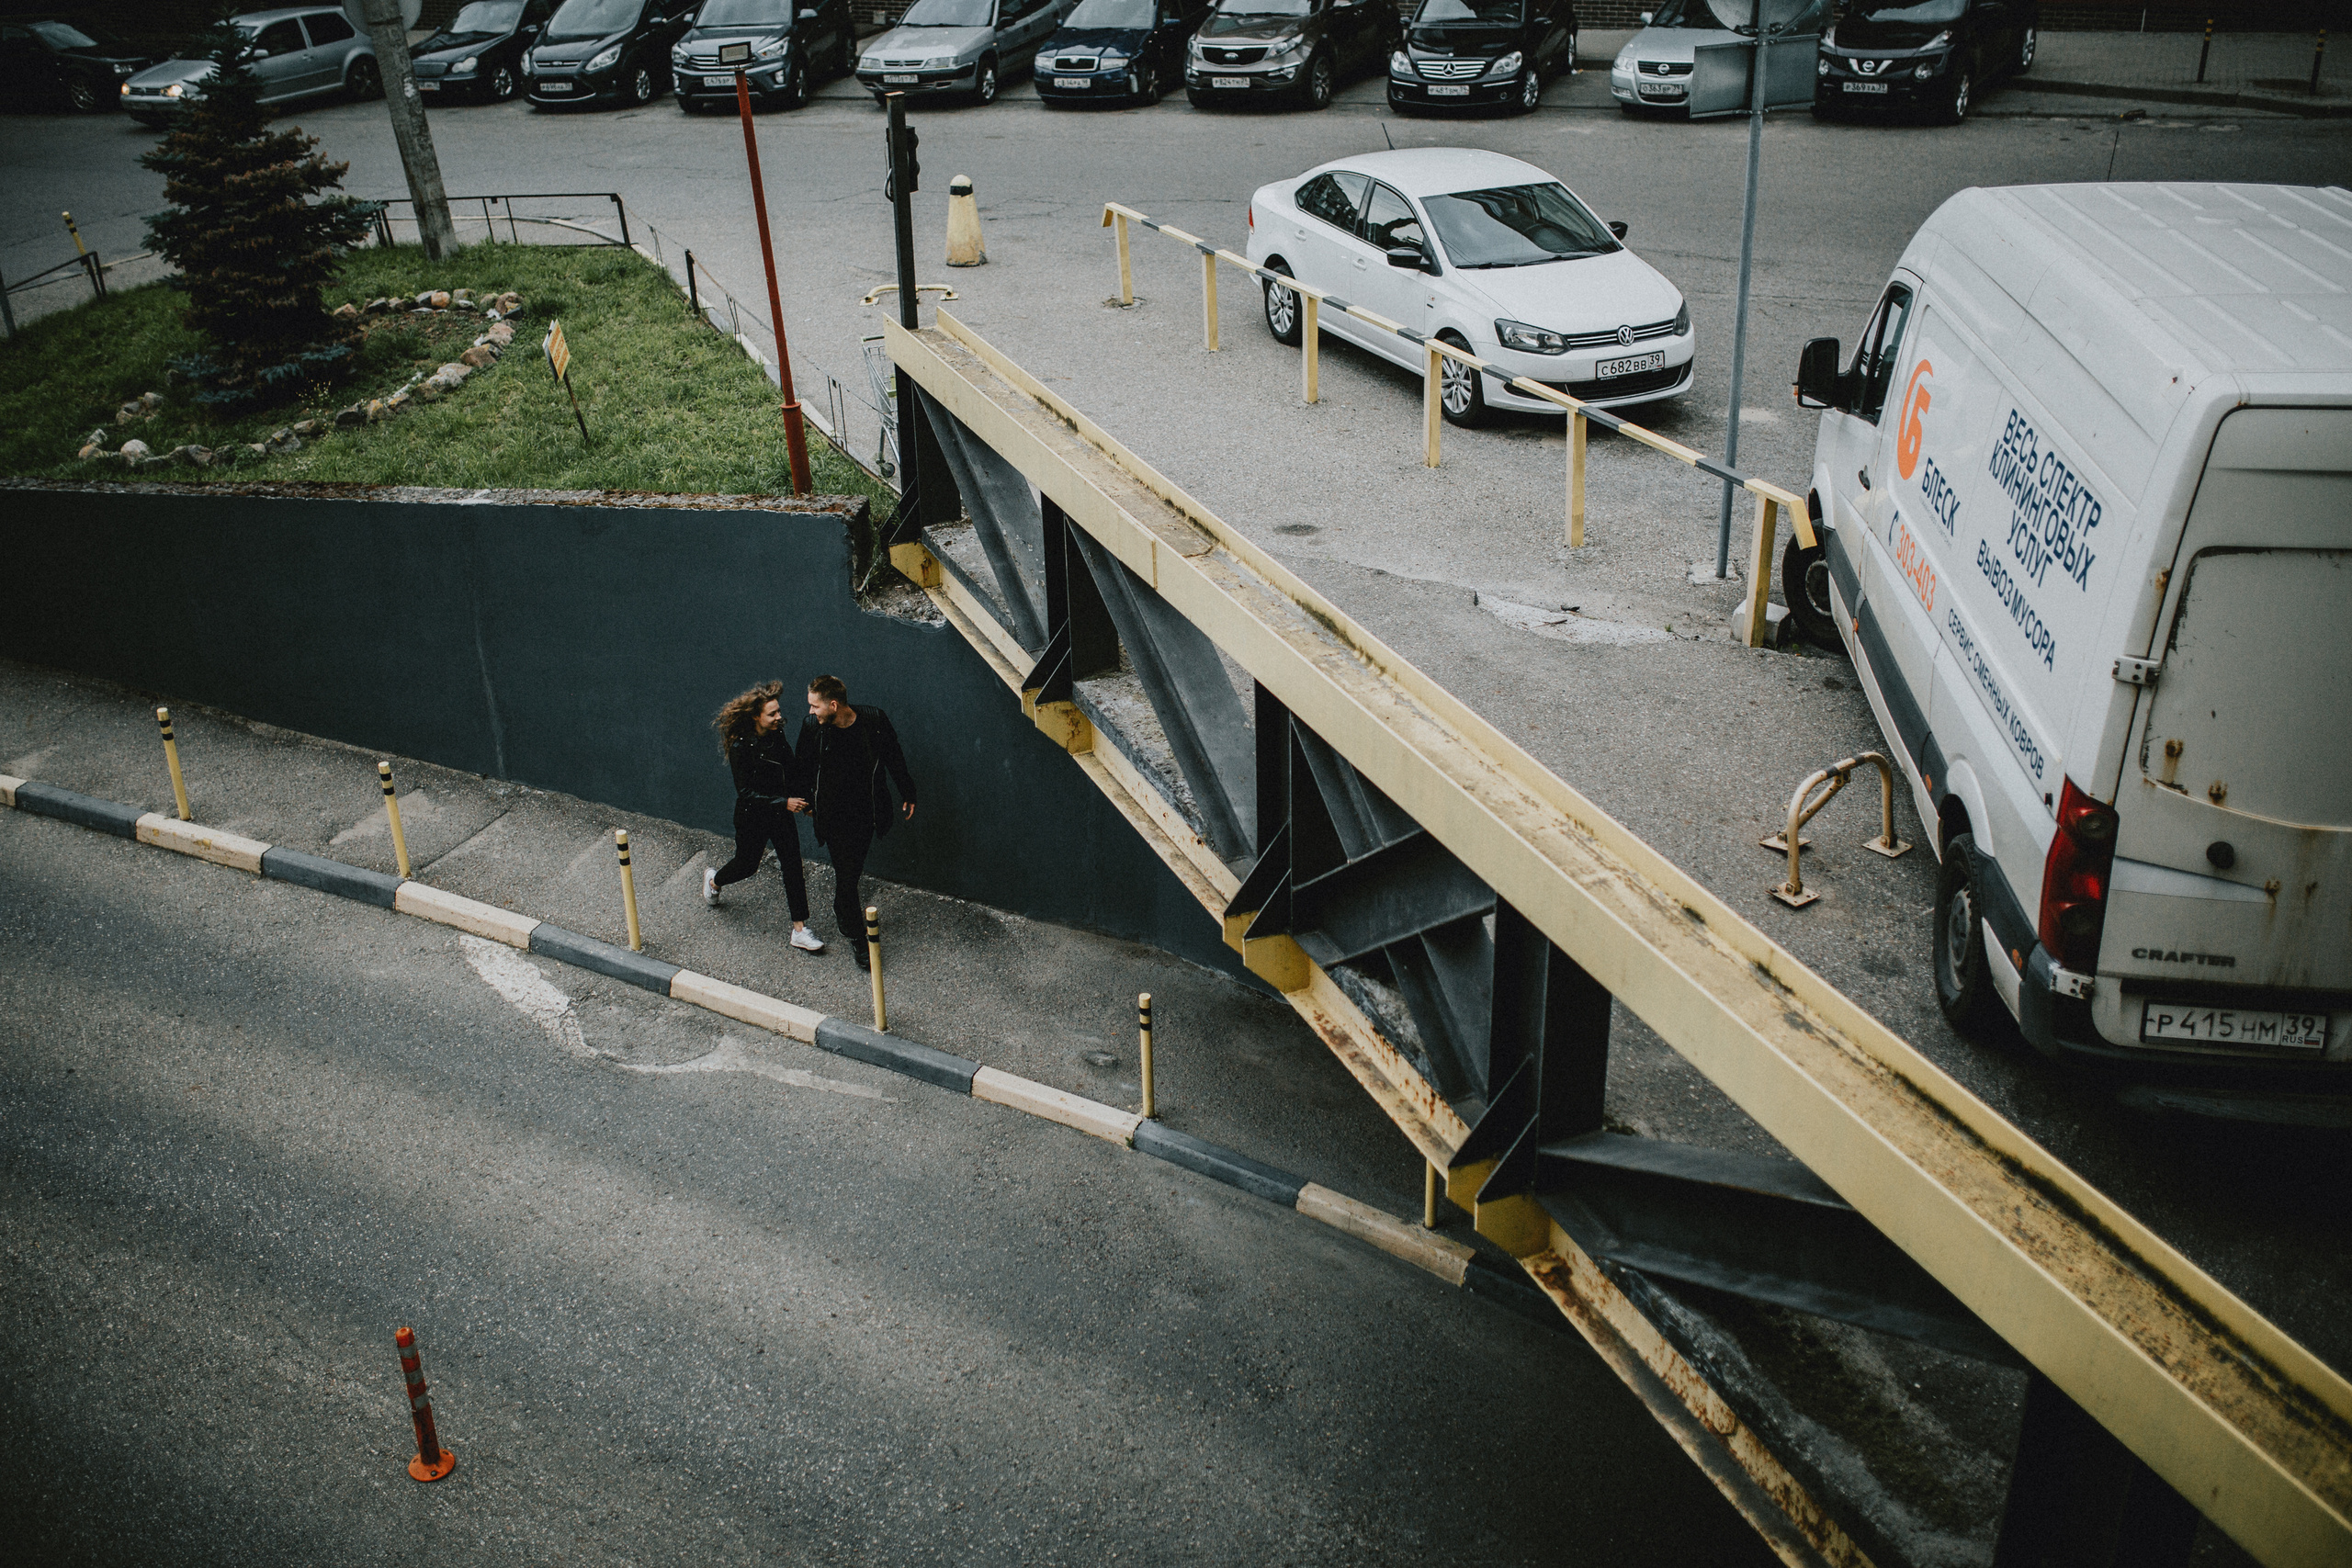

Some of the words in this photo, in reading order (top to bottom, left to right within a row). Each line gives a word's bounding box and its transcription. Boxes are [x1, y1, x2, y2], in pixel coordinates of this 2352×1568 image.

[1921, 457, 1961, 537] БЛЕСК
[2002, 408, 2039, 474] ВЕСЬ
[2040, 451, 2102, 537] СПЕКТР
[1989, 439, 2096, 592] КЛИНИНГОВЫХ
[2007, 509, 2053, 588] УСЛУГ
[1896, 524, 1936, 613] 303-403
[1977, 538, 2013, 607] ВЫВОЗ
[2010, 588, 2055, 672] МУСОРА
[1948, 608, 1974, 662] СЕРВИС
[1973, 652, 2010, 725] СМЕННЫХ
[2009, 711, 2044, 780] КОВРОВ
[2132, 947, 2236, 967] CRAFTER
[2282, 1034, 2303, 1044] RUS
[2286, 1015, 2316, 1037] 39
